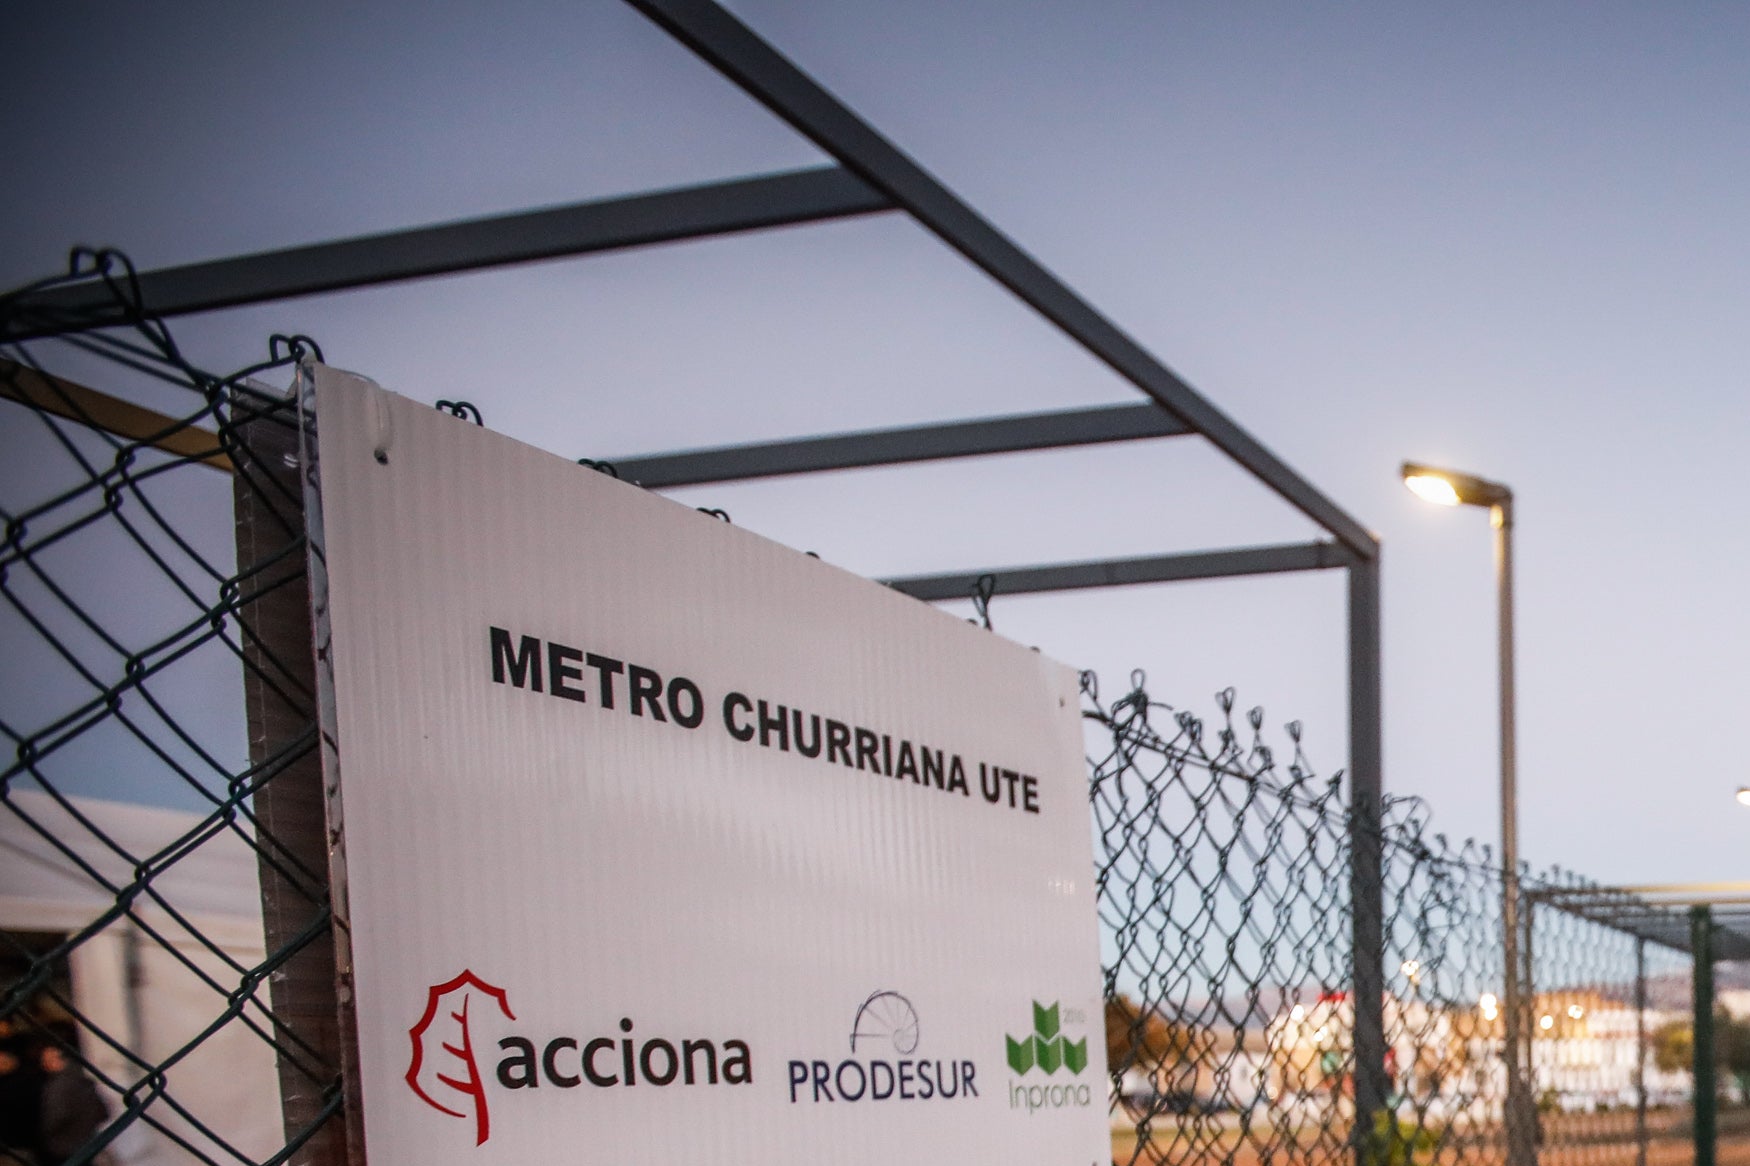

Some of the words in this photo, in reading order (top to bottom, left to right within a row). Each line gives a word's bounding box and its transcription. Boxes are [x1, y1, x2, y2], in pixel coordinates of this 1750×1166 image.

[490, 626, 705, 730] METRO
[723, 691, 971, 798] CHURRIANA
[978, 762, 1041, 815] UTE
[496, 1018, 754, 1090] acciona
[789, 1060, 980, 1104] PRODESUR
[1009, 1080, 1090, 1115] Inprona
